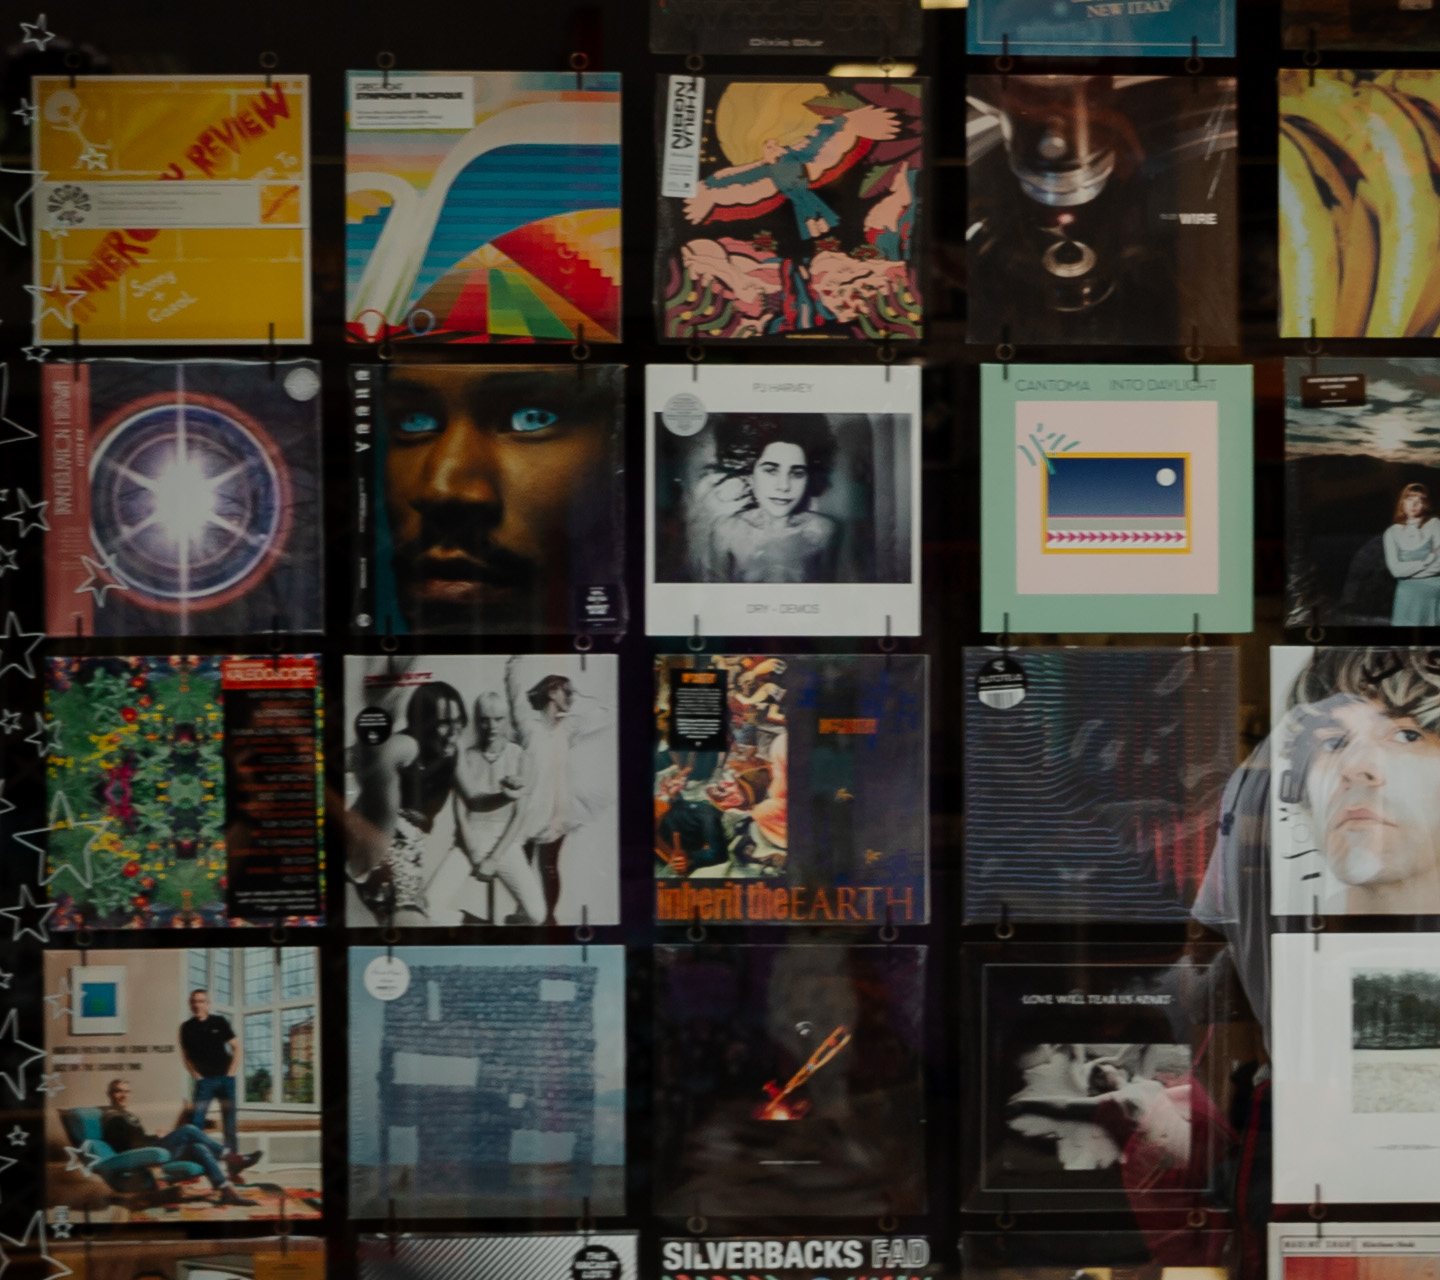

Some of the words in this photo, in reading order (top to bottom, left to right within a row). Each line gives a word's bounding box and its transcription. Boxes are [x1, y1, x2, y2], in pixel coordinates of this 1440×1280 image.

[1086, 3, 1125, 17] NEW
[1128, 0, 1173, 14] ITALY
[185, 81, 290, 179] REVIEW
[1178, 213, 1218, 224] WIRE
[768, 382, 815, 393] HARVEY
[1015, 379, 1091, 392] CANTOMA
[1109, 379, 1145, 392] INTO
[656, 880, 745, 920] inherit
[746, 880, 789, 920] the
[790, 886, 915, 921] EARTH
[662, 1239, 865, 1271] SILVERBACKS
[871, 1238, 931, 1270] FAD
